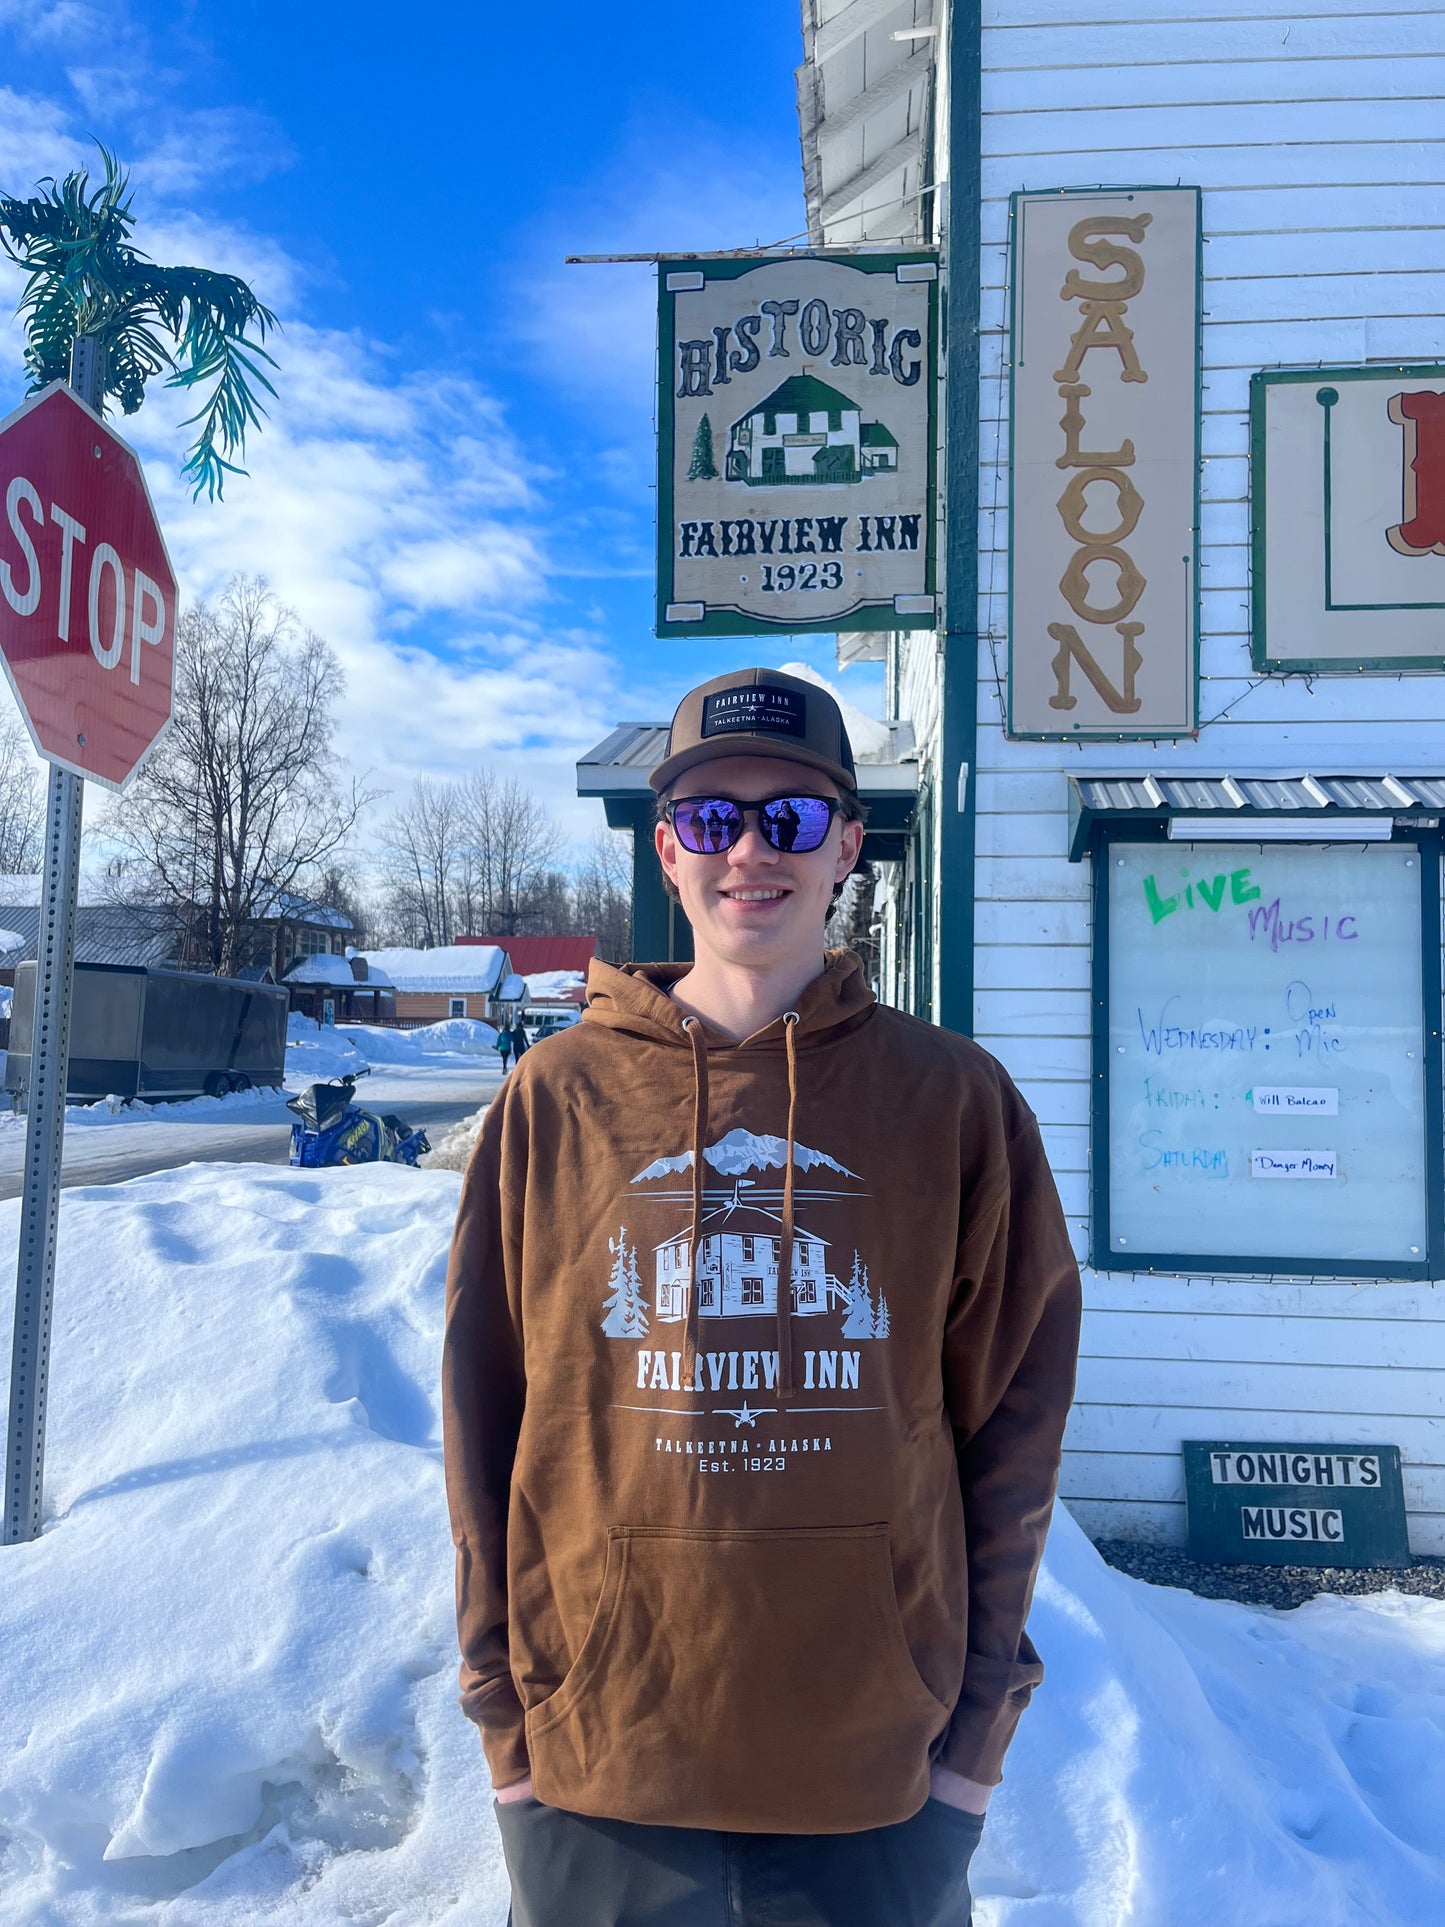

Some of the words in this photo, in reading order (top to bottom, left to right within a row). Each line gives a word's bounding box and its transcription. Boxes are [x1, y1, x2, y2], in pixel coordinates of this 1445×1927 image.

[677, 298, 922, 398] HISTORIC
[1047, 212, 1153, 714] SALOON
[678, 516, 848, 558] FAIRVIEW
[856, 514, 922, 552] INN
[0, 476, 166, 687] STOP
[761, 561, 844, 592] 1923
[716, 693, 765, 708] FAIRVIEW
[772, 695, 789, 706] INN
[714, 715, 756, 726] TALKEETNA
[761, 715, 790, 725] ALASKA
[1295, 1024, 1347, 1064] Mic
[1259, 1094, 1280, 1106] Will
[1255, 1156, 1298, 1173] Danger
[803, 1350, 861, 1390] INN
[655, 1438, 750, 1454] TALKEETNA
[768, 1437, 832, 1453] ALASKA
[699, 1459, 736, 1473] Est.
[743, 1457, 786, 1472] 1923
[1213, 1453, 1378, 1485] TONIGHTS
[1243, 1508, 1341, 1540] MUSIC
